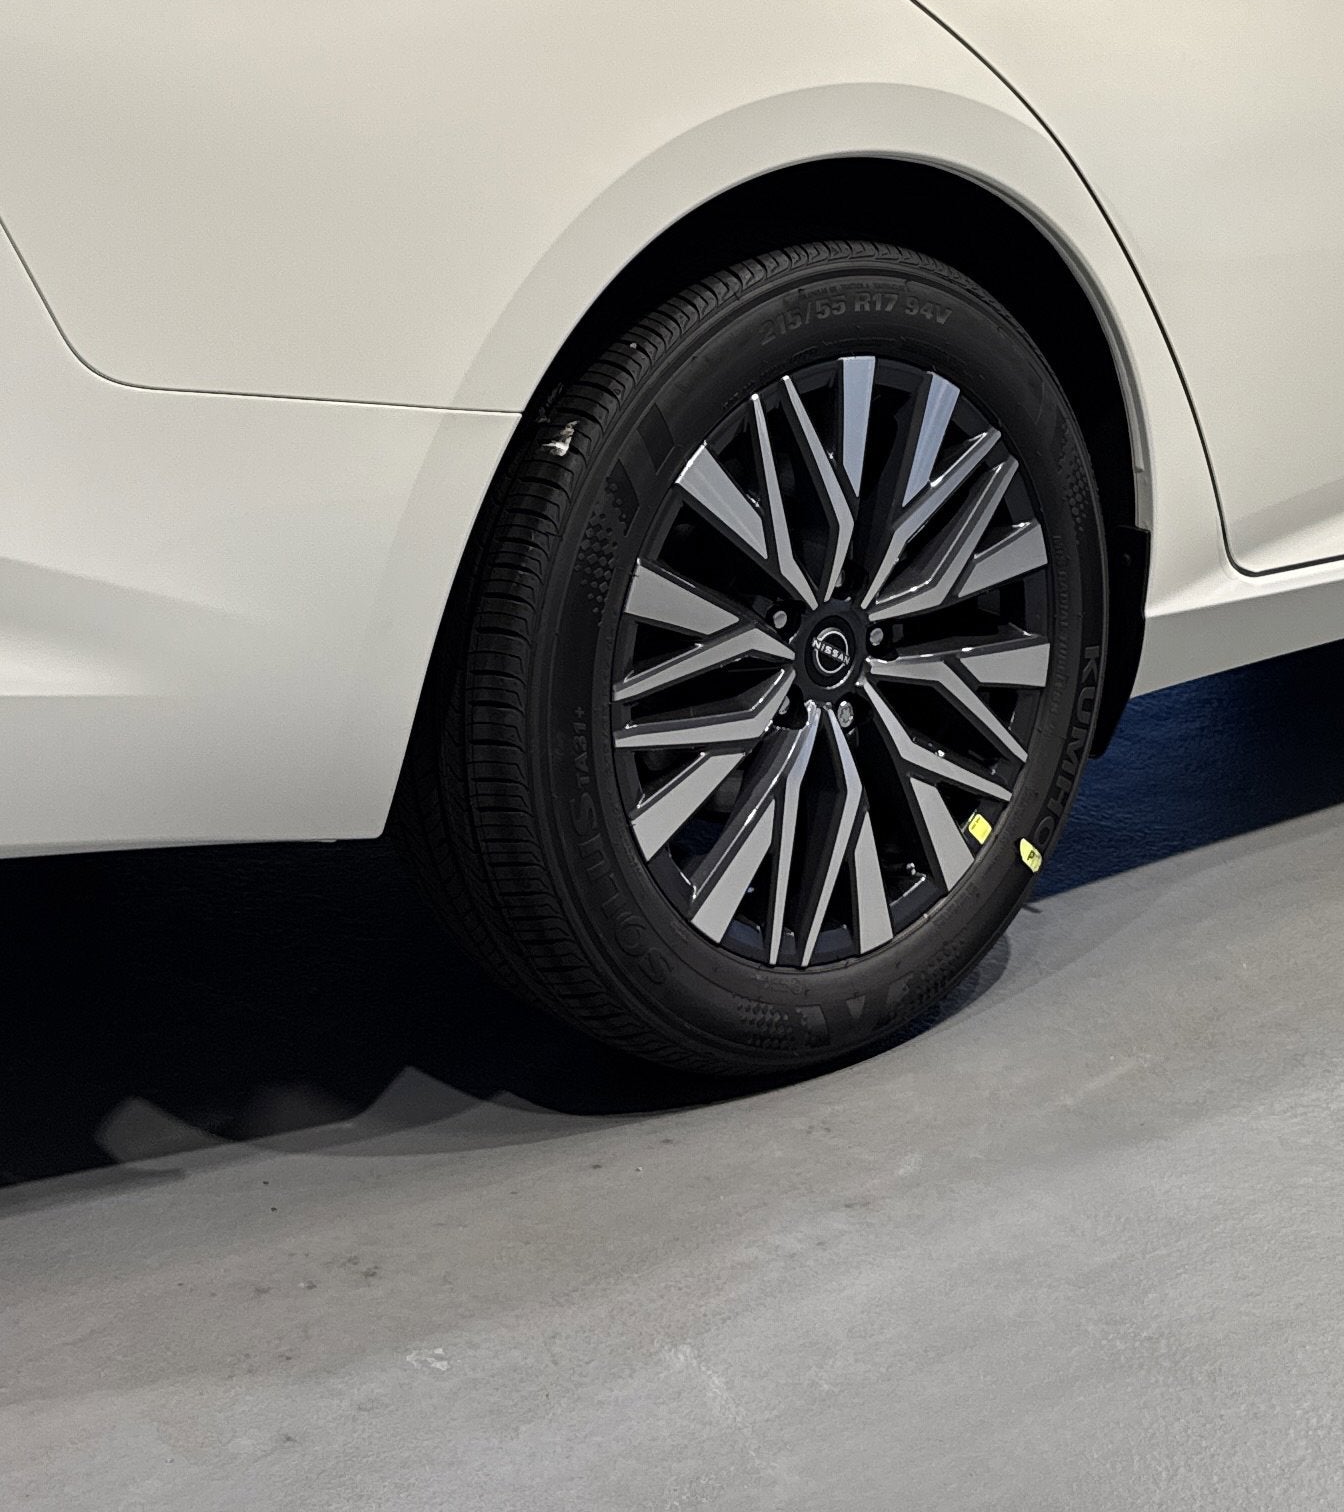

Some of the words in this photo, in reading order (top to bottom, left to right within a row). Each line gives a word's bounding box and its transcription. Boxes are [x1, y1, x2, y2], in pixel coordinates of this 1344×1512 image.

[759, 296, 847, 346] 215/55
[853, 292, 899, 314] R17
[905, 295, 953, 326] 94V
[811, 637, 850, 666] NISSAN
[1032, 645, 1101, 850] KUMHO
[571, 797, 676, 984] SOLUS
